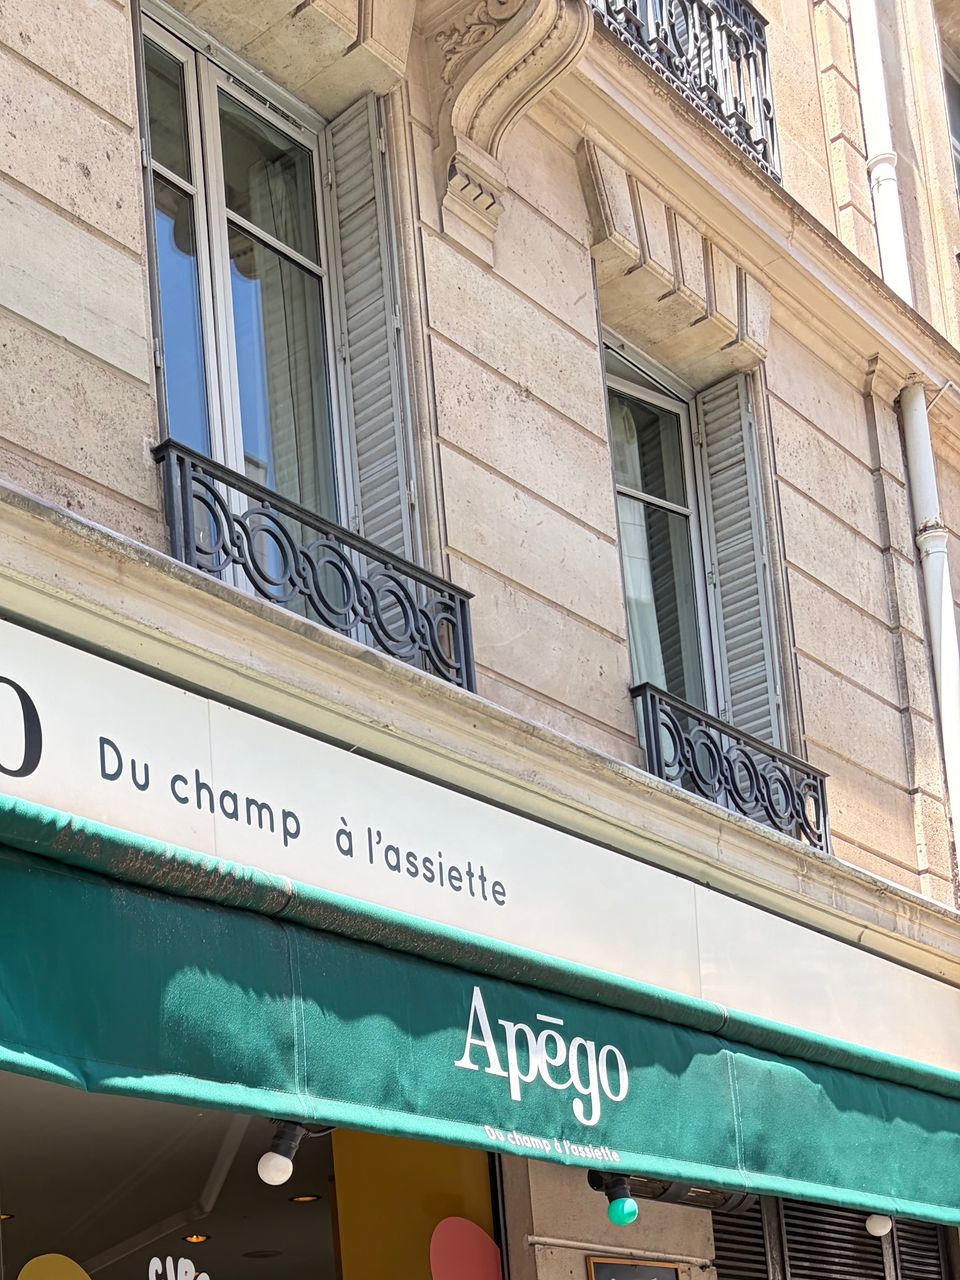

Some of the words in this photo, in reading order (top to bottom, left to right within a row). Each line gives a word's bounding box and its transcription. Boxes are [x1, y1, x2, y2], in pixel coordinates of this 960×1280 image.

[98, 736, 150, 791] Du
[170, 769, 301, 846] champ
[336, 817, 354, 858] à
[367, 826, 507, 906] l'assiette
[484, 1125, 505, 1141] Du
[507, 1130, 551, 1153] champ
[553, 1138, 561, 1154] à
